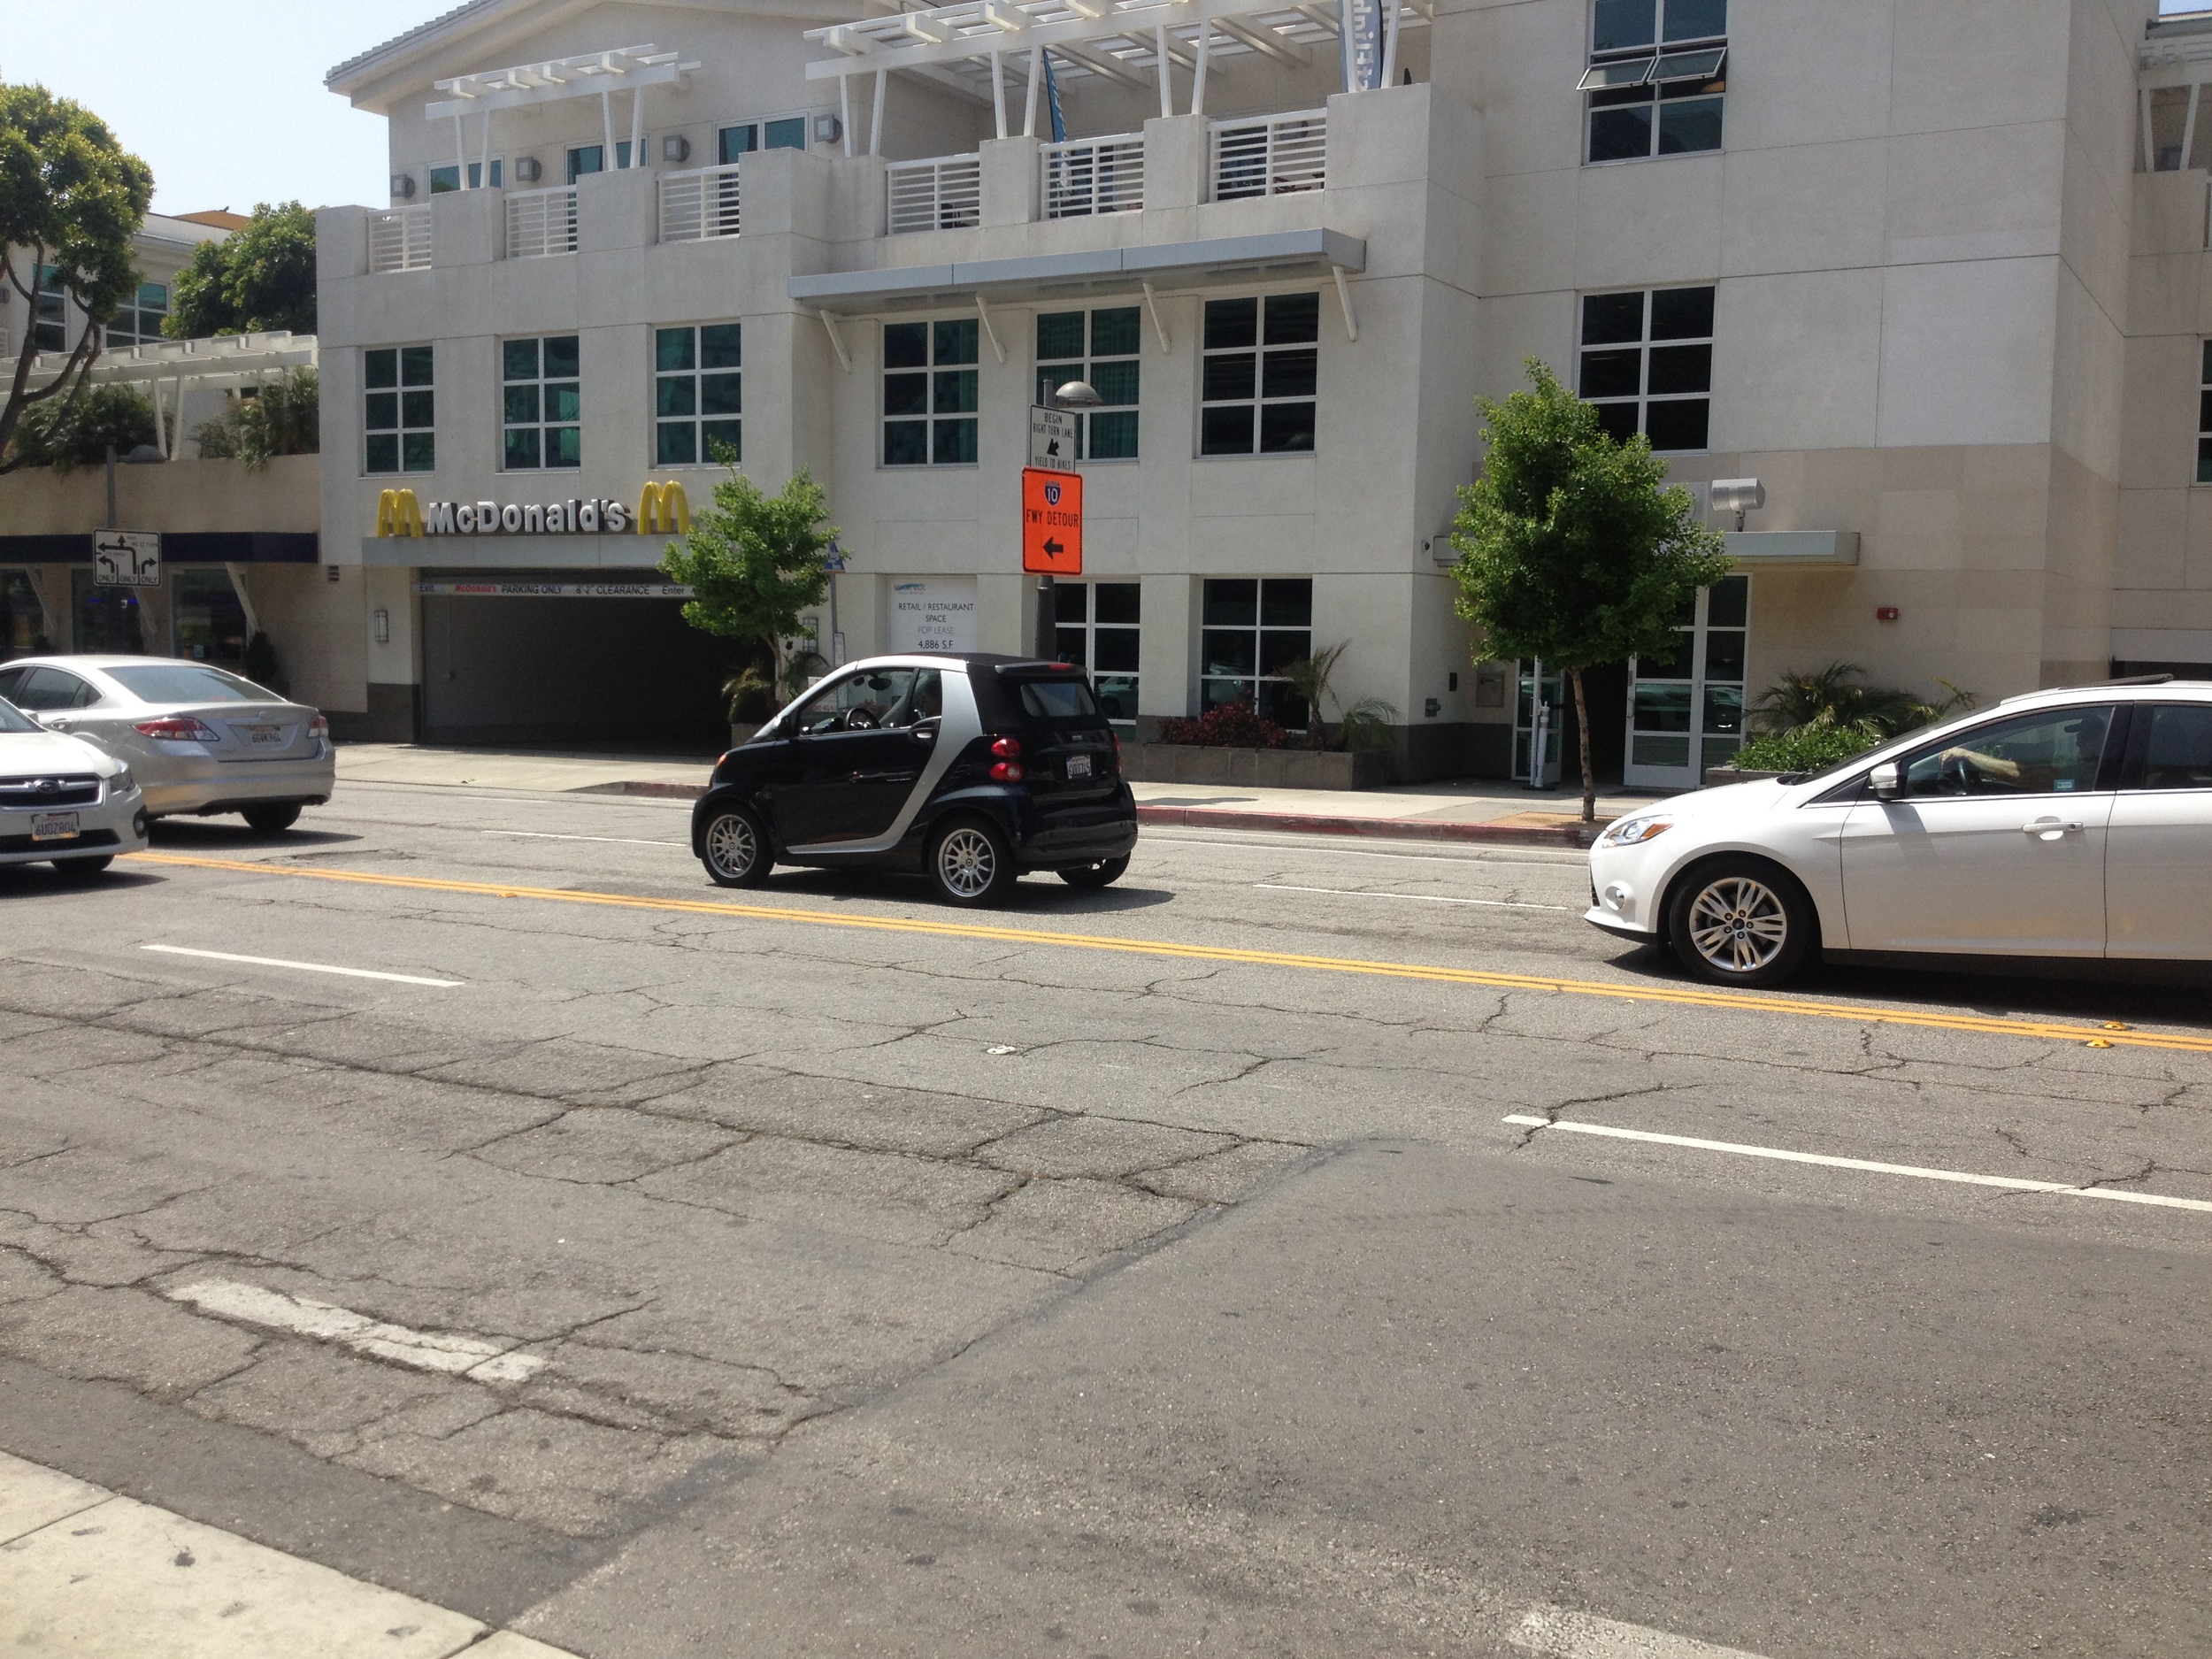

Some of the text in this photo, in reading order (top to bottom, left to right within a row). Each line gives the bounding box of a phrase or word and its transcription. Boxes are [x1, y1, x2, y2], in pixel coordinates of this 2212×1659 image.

[1044, 412, 1063, 425] BEGIN
[1033, 422, 1073, 439] RIGHT TURN LANE
[1034, 456, 1071, 471] YIELD TO BIKES
[1048, 488, 1058, 503] 10
[427, 499, 632, 534] McDonald's
[1026, 508, 1079, 528] FWY DETOUR
[455, 584, 564, 595] McDonald's PARKING ONLY
[596, 586, 650, 595] CLEARANCE
[662, 585, 686, 595] Enter
[918, 626, 955, 634] FOR LEASE
